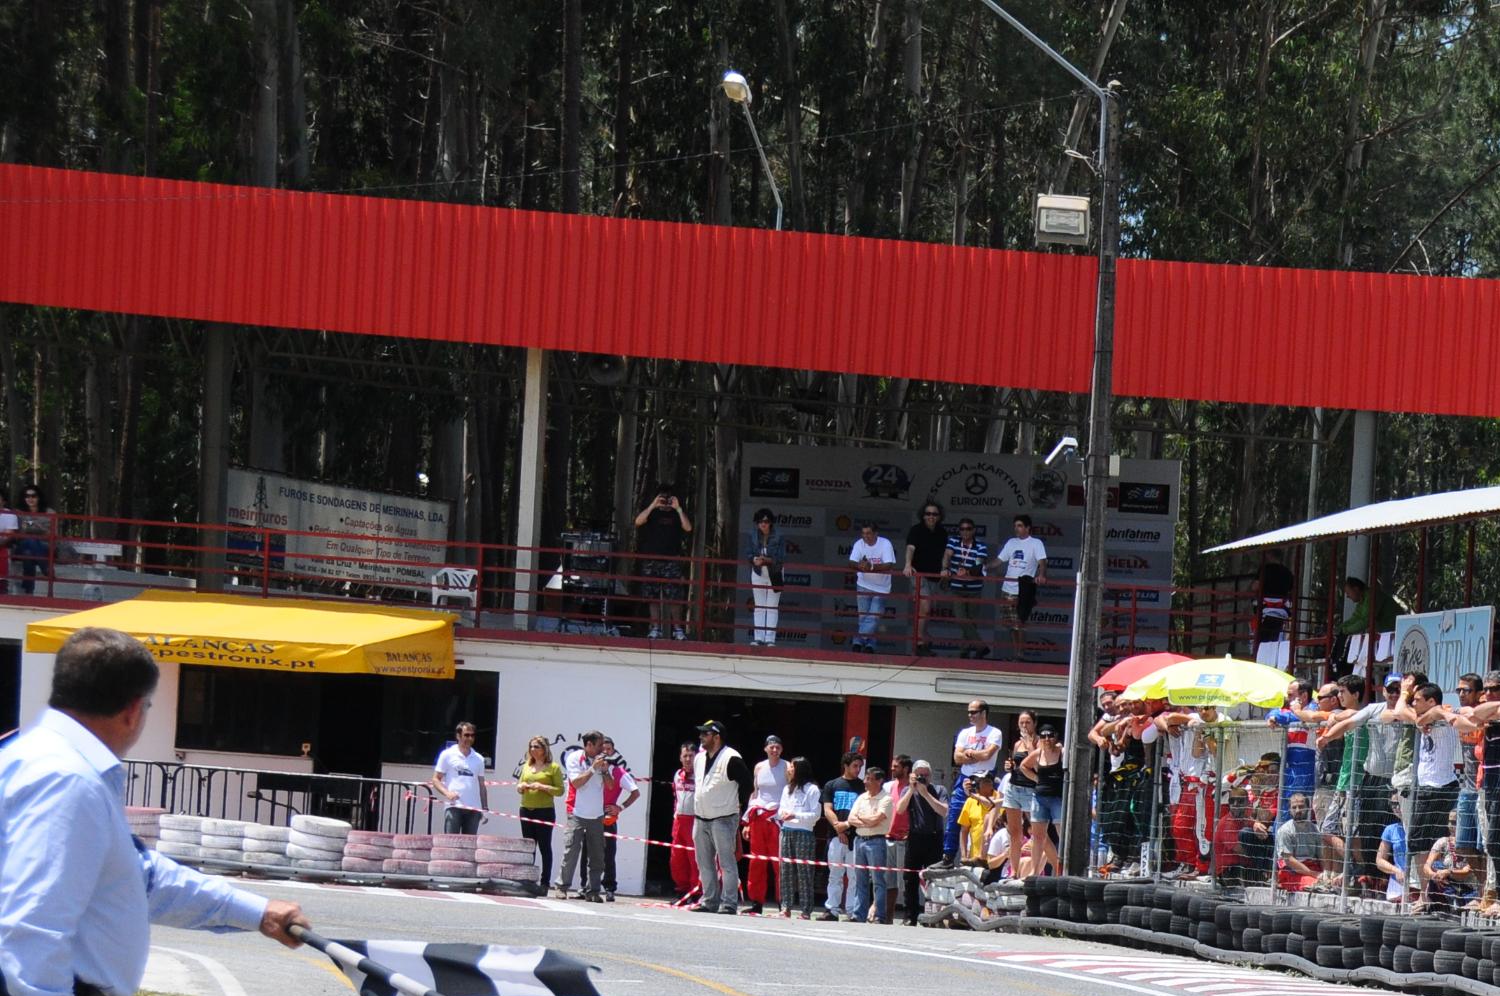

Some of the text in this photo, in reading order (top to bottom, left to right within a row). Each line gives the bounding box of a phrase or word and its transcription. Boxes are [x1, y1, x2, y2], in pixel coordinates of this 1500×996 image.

[868, 466, 899, 483] 24
[805, 479, 852, 488] HONDA
[976, 462, 1027, 507] KARTING
[279, 487, 308, 501] FUROS
[309, 493, 316, 503] E
[316, 495, 368, 512] SONDAGENS
[369, 503, 381, 513] DE
[951, 496, 1005, 507] EUROINDY
[1106, 558, 1150, 569] HELIX
[144, 635, 275, 655] ALANÇAS
